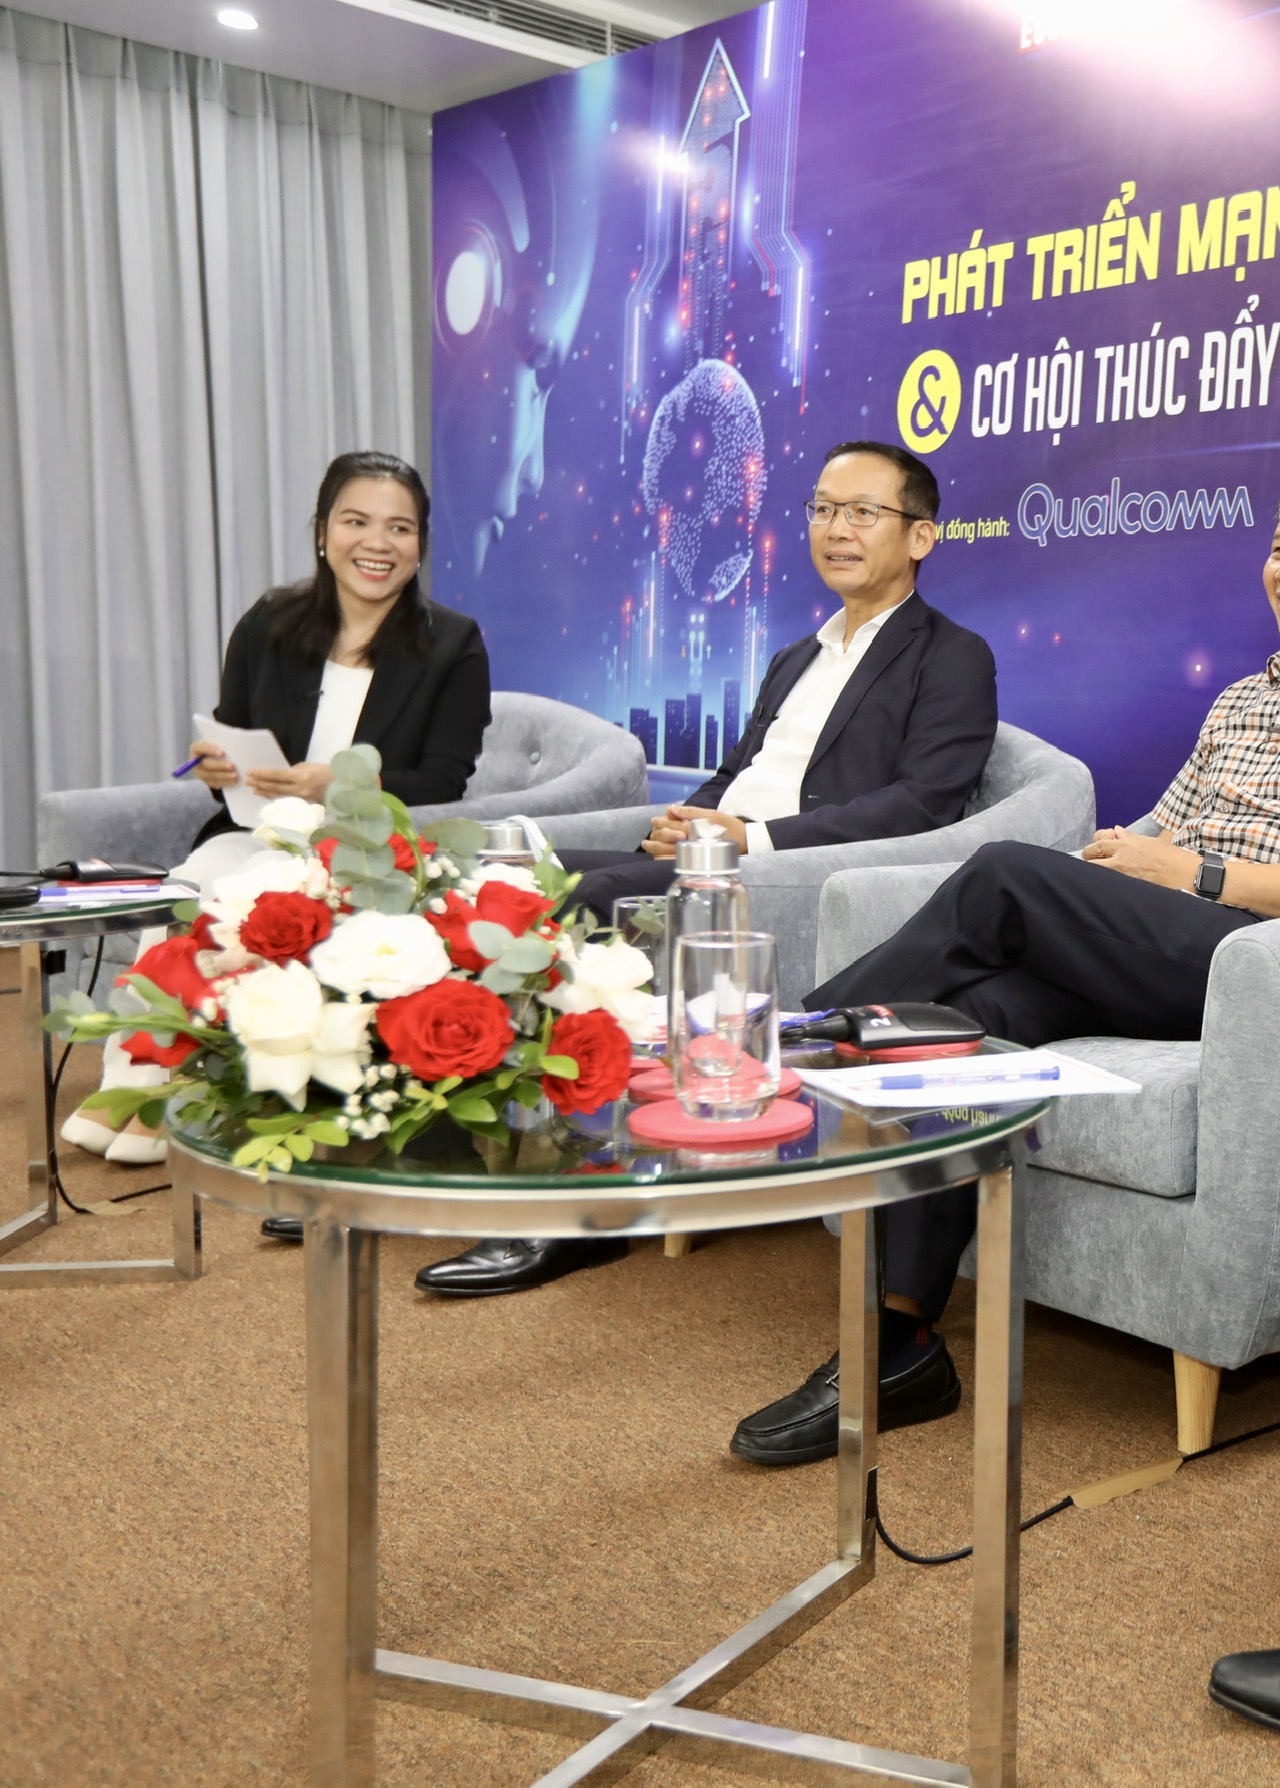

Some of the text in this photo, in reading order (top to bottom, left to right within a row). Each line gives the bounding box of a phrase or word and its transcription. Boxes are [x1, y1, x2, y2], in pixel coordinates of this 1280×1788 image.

[901, 229, 1014, 324] PHÁT
[1027, 181, 1161, 300] TRIỂN
[970, 352, 1021, 438] CƠ
[1023, 337, 1084, 446] HỘI
[1094, 322, 1189, 424] THÚC
[1017, 477, 1254, 547] Qualcomm
